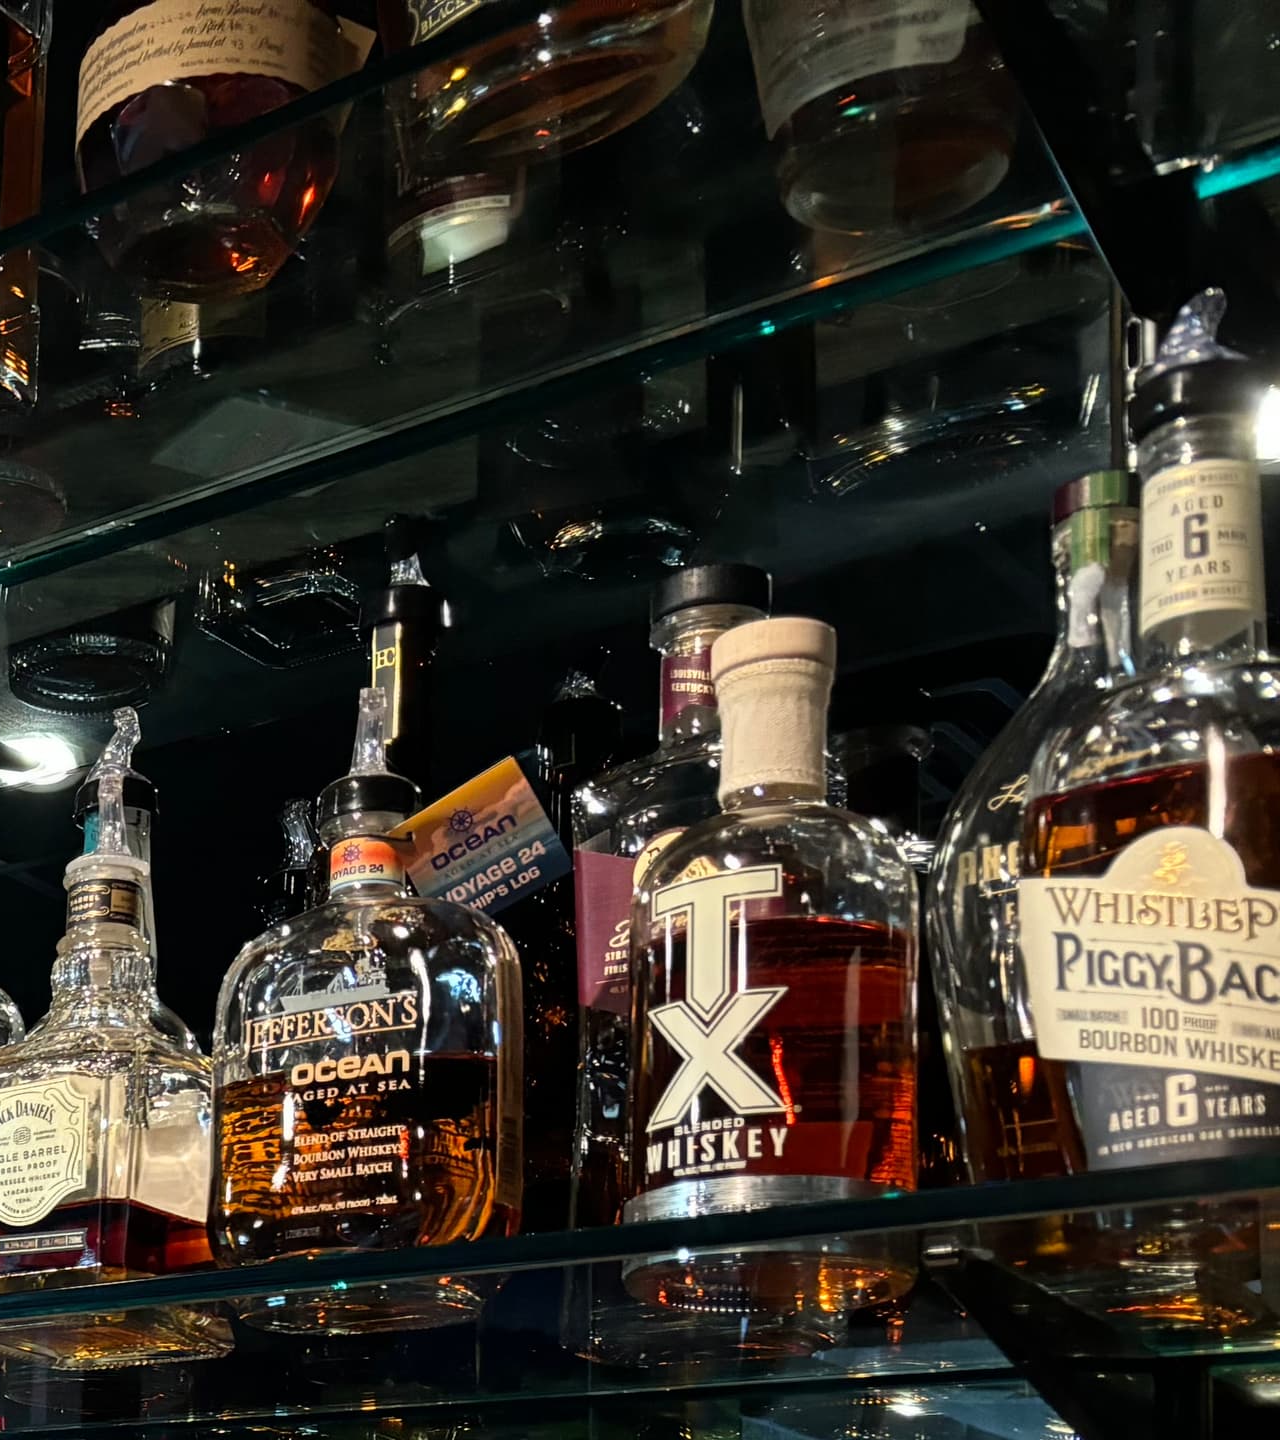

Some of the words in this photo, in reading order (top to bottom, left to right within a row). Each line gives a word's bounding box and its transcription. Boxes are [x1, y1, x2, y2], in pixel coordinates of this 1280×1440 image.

[1171, 495, 1224, 516] AGED
[1184, 513, 1209, 559] 6
[1165, 560, 1232, 582] YEARS
[516, 840, 547, 865] 24
[368, 863, 384, 874] 24
[510, 866, 541, 888] LOG
[1046, 887, 1280, 941] WHISTLEP
[1052, 932, 1280, 1004] PIGGYBAC
[1141, 1007, 1179, 1031] 100
[1079, 1028, 1179, 1056] BOURBON
[1187, 1037, 1280, 1071] WHISKE
[347, 1082, 369, 1096] AT
[377, 1079, 411, 1092] SEA
[15, 1100, 56, 1125] DANIEL'S
[1108, 1108, 1160, 1133] AGED
[1165, 1072, 1199, 1127] 6
[1205, 1093, 1267, 1119] YEARS
[674, 1118, 745, 1136] BLENDED
[23, 1145, 68, 1160] BARREL
[646, 1127, 788, 1174] WHISKEY
[27, 1160, 58, 1171] PROOF
